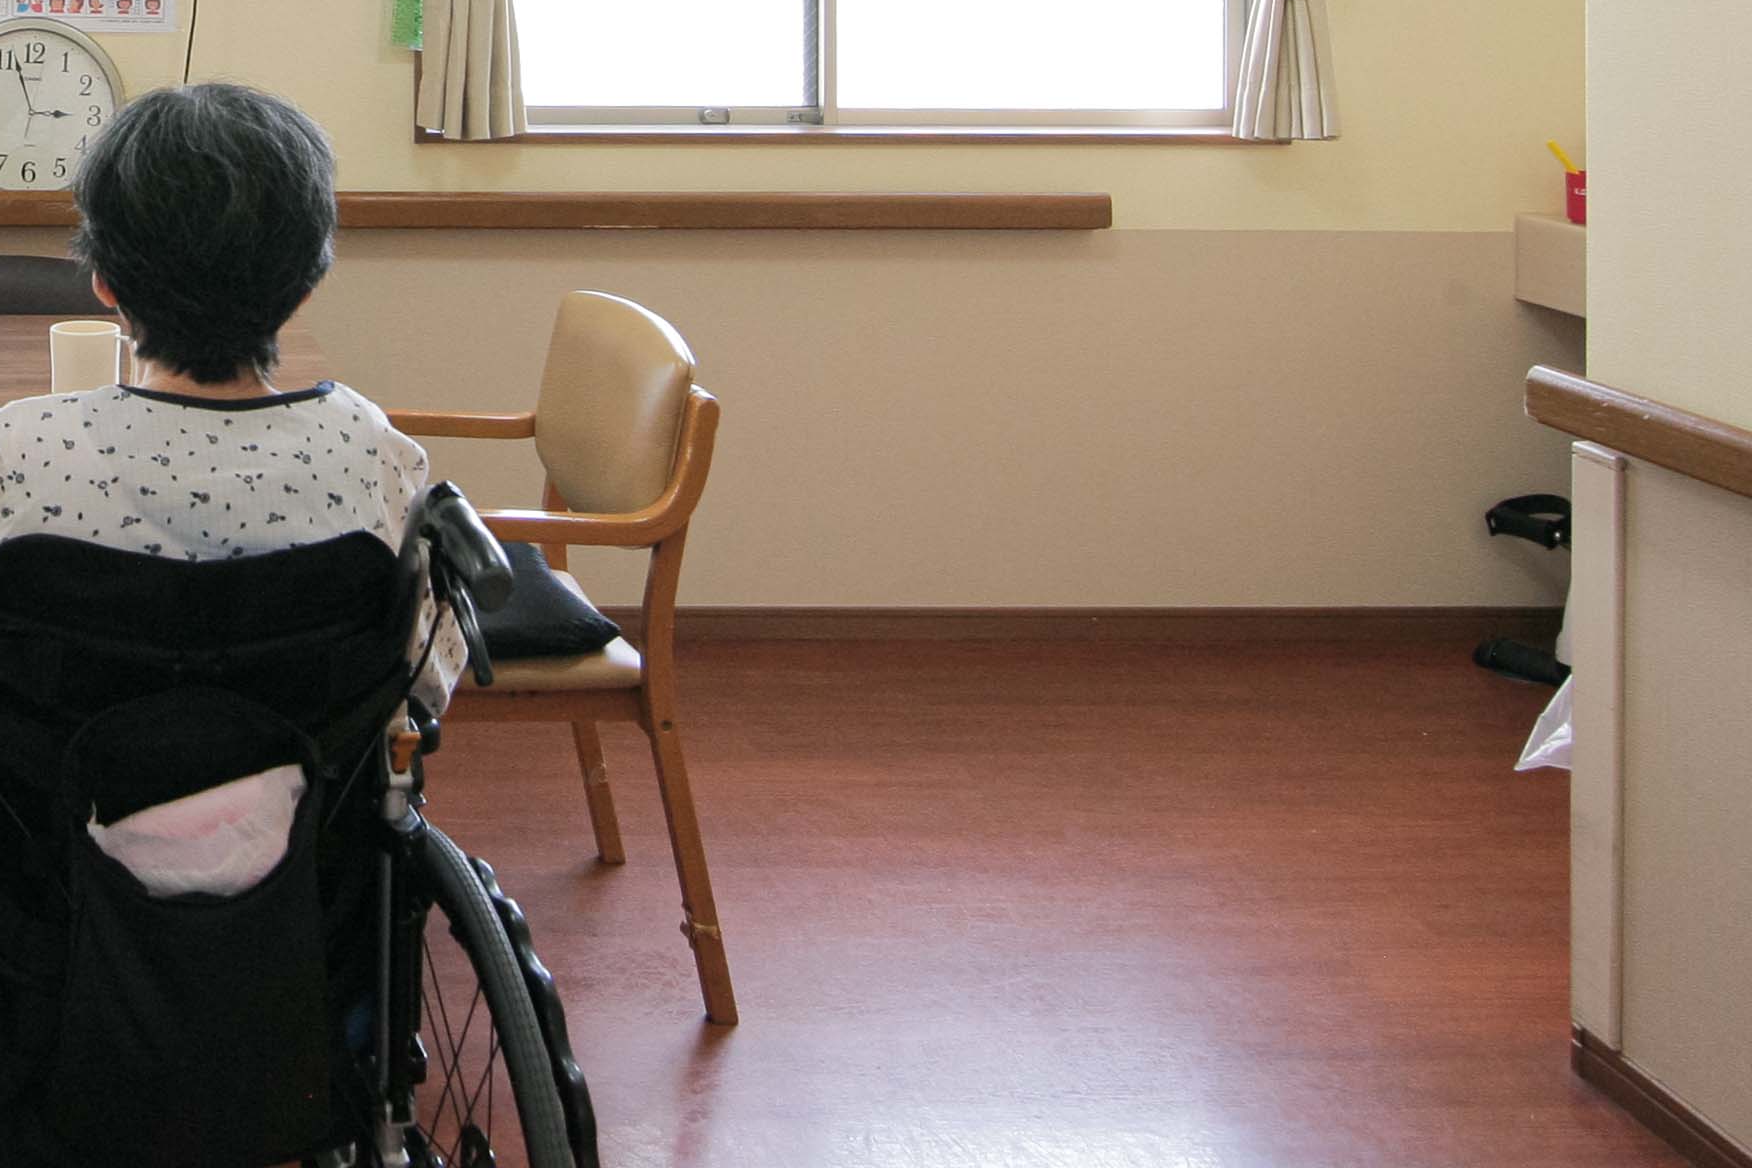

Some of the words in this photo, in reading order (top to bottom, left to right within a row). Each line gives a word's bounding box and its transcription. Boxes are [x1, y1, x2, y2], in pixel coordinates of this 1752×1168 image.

[24, 43, 45, 64] 12
[62, 52, 70, 72] 1
[79, 75, 92, 96] 2
[87, 106, 101, 126] 3
[75, 135, 89, 155] 4
[21, 162, 36, 183] 6
[53, 158, 66, 177] 5
